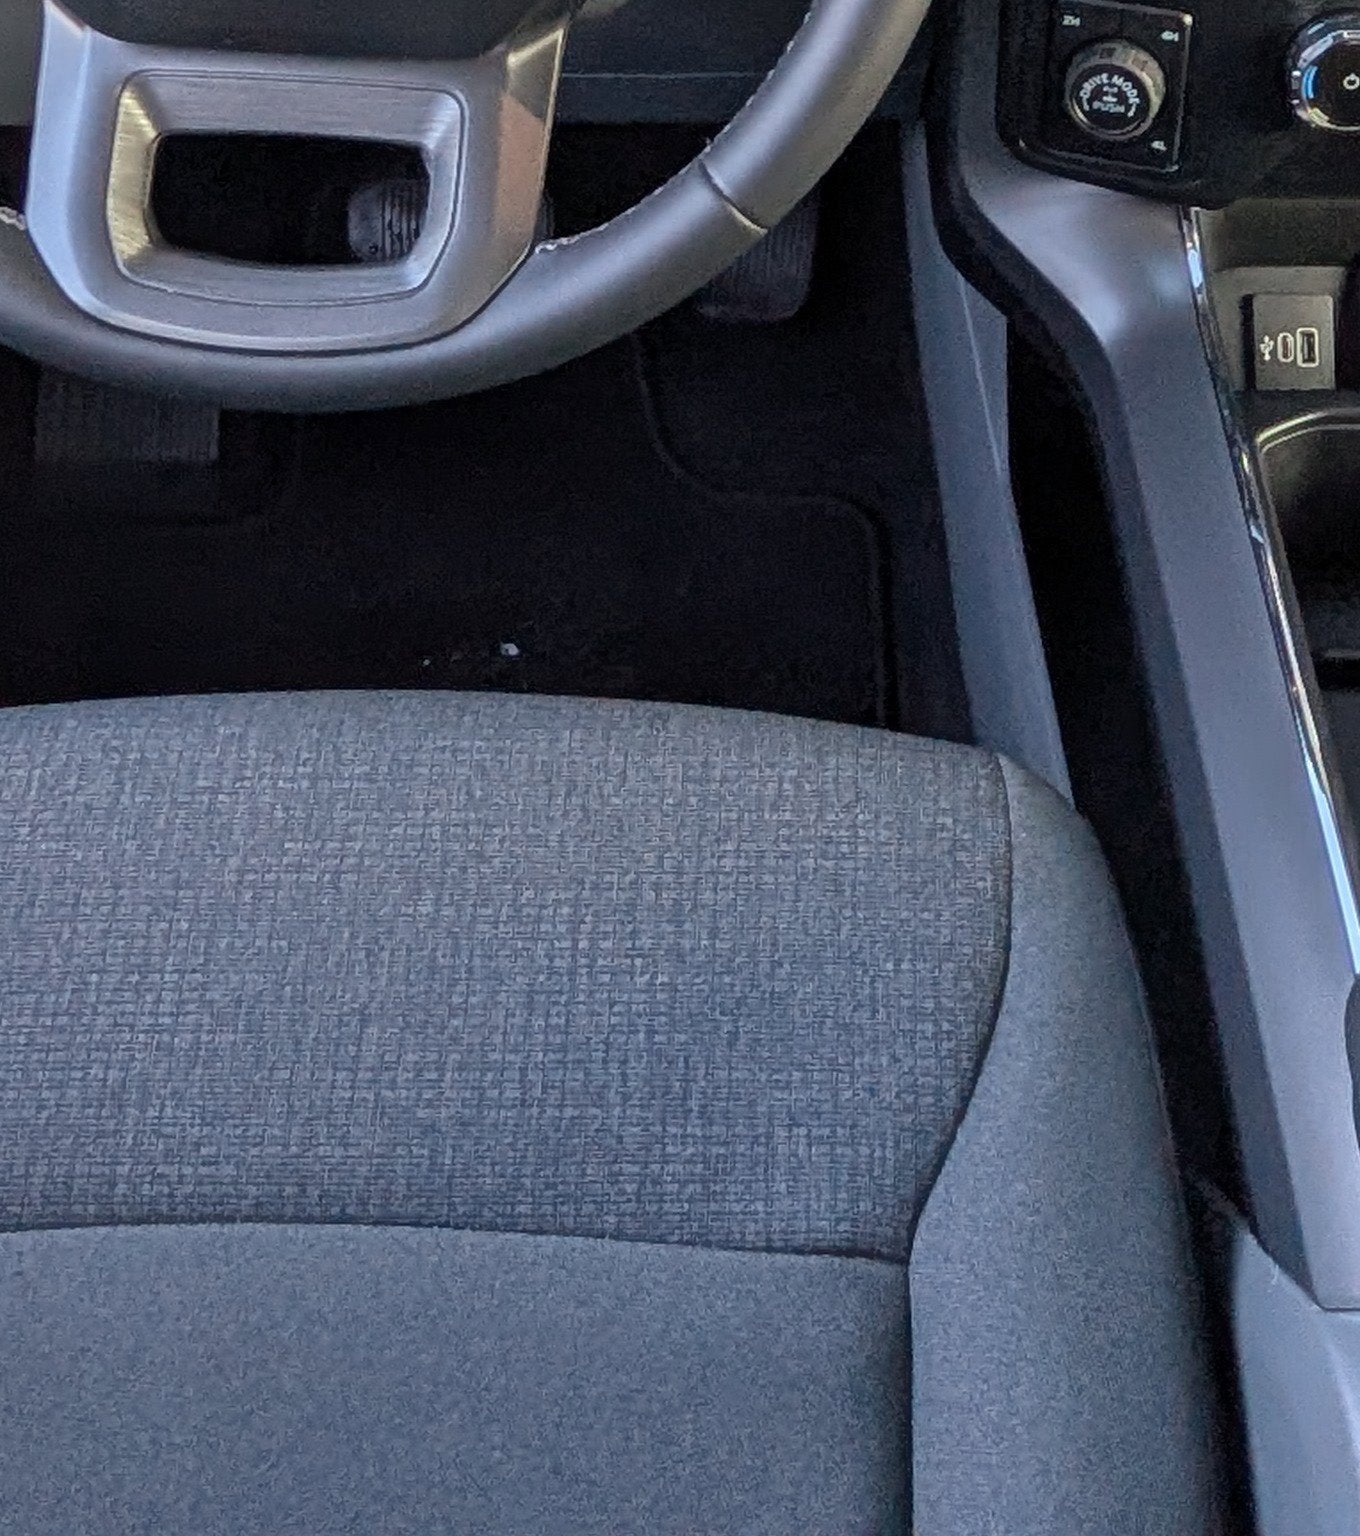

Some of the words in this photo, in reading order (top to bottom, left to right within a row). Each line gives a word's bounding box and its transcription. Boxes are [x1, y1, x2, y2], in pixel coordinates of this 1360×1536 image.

[1080, 73, 1109, 98] DRIVE
[1111, 74, 1140, 104] MODE
[1092, 101, 1126, 113] PUSH
